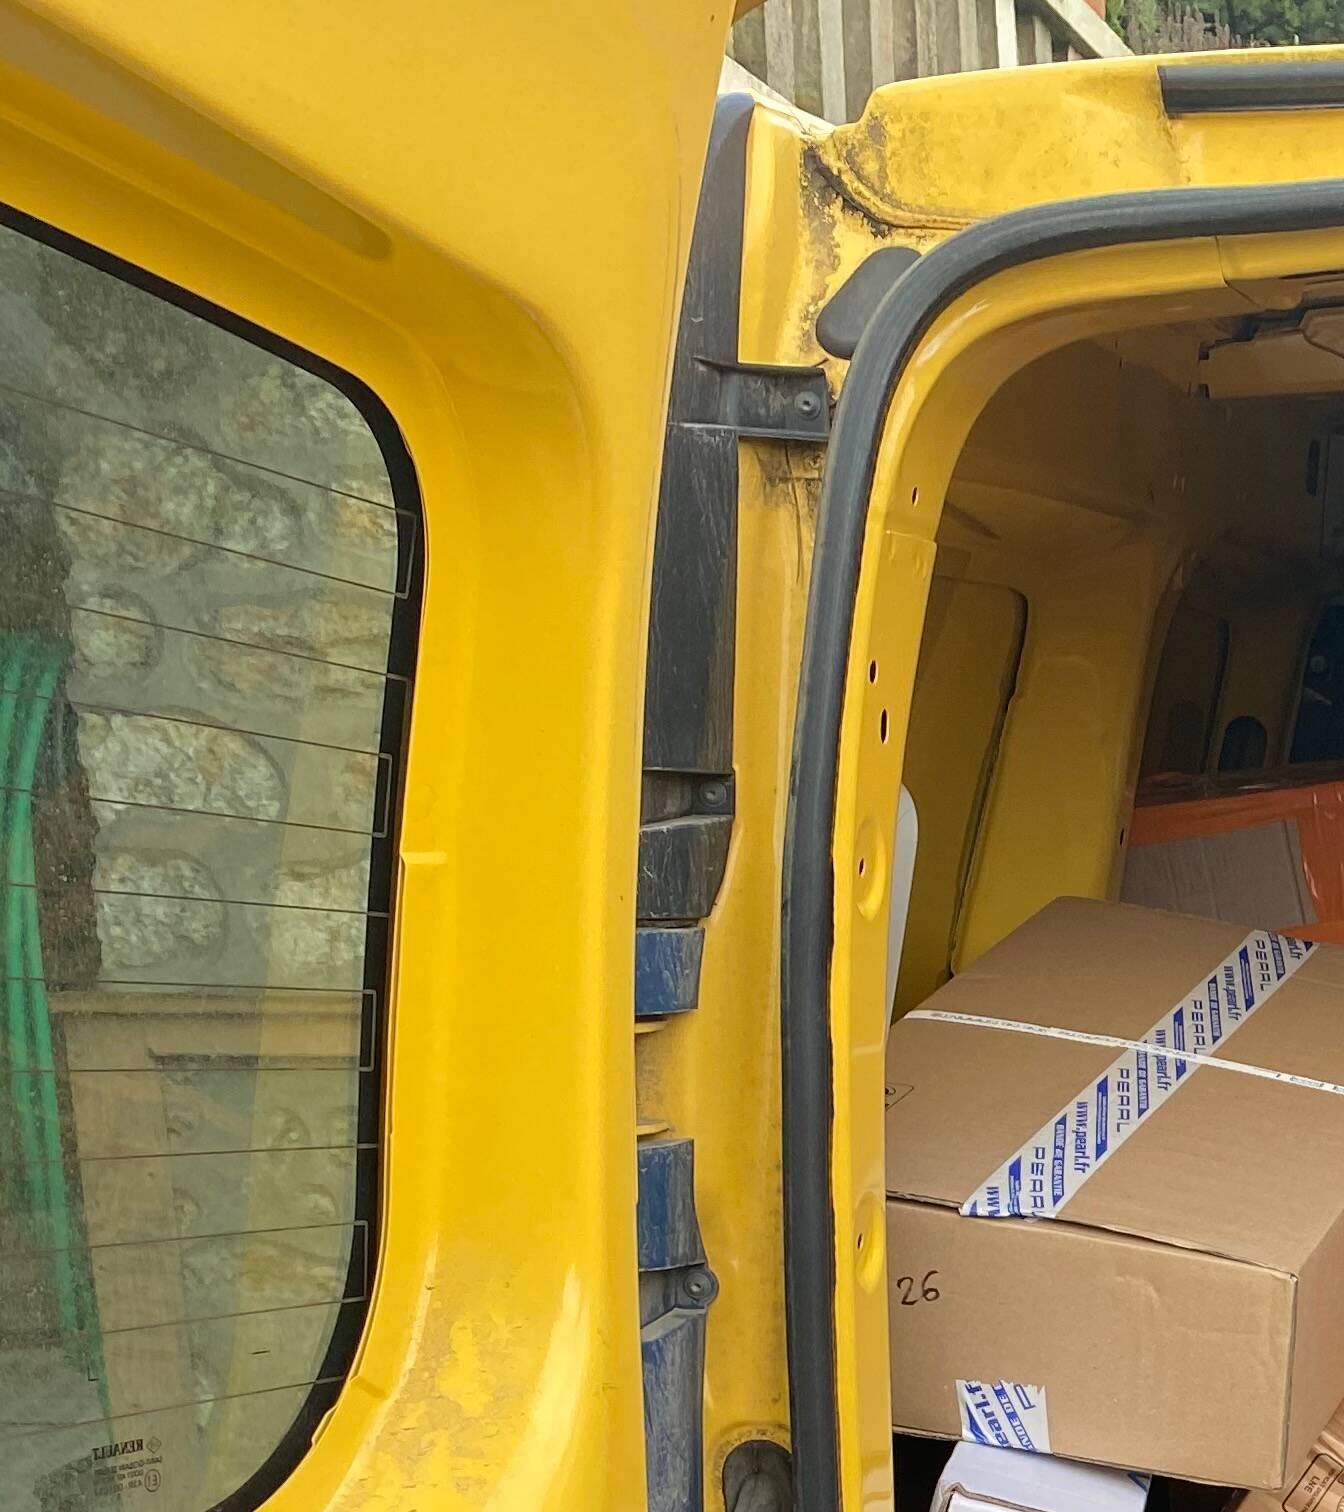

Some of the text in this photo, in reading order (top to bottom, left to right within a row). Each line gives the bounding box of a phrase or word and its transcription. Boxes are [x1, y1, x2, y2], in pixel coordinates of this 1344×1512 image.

[1255, 939, 1271, 991] PEARL
[1116, 1068, 1131, 1133] PEARL
[1071, 1101, 1090, 1174] www.pearl.fr
[897, 1270, 940, 1306] 26
